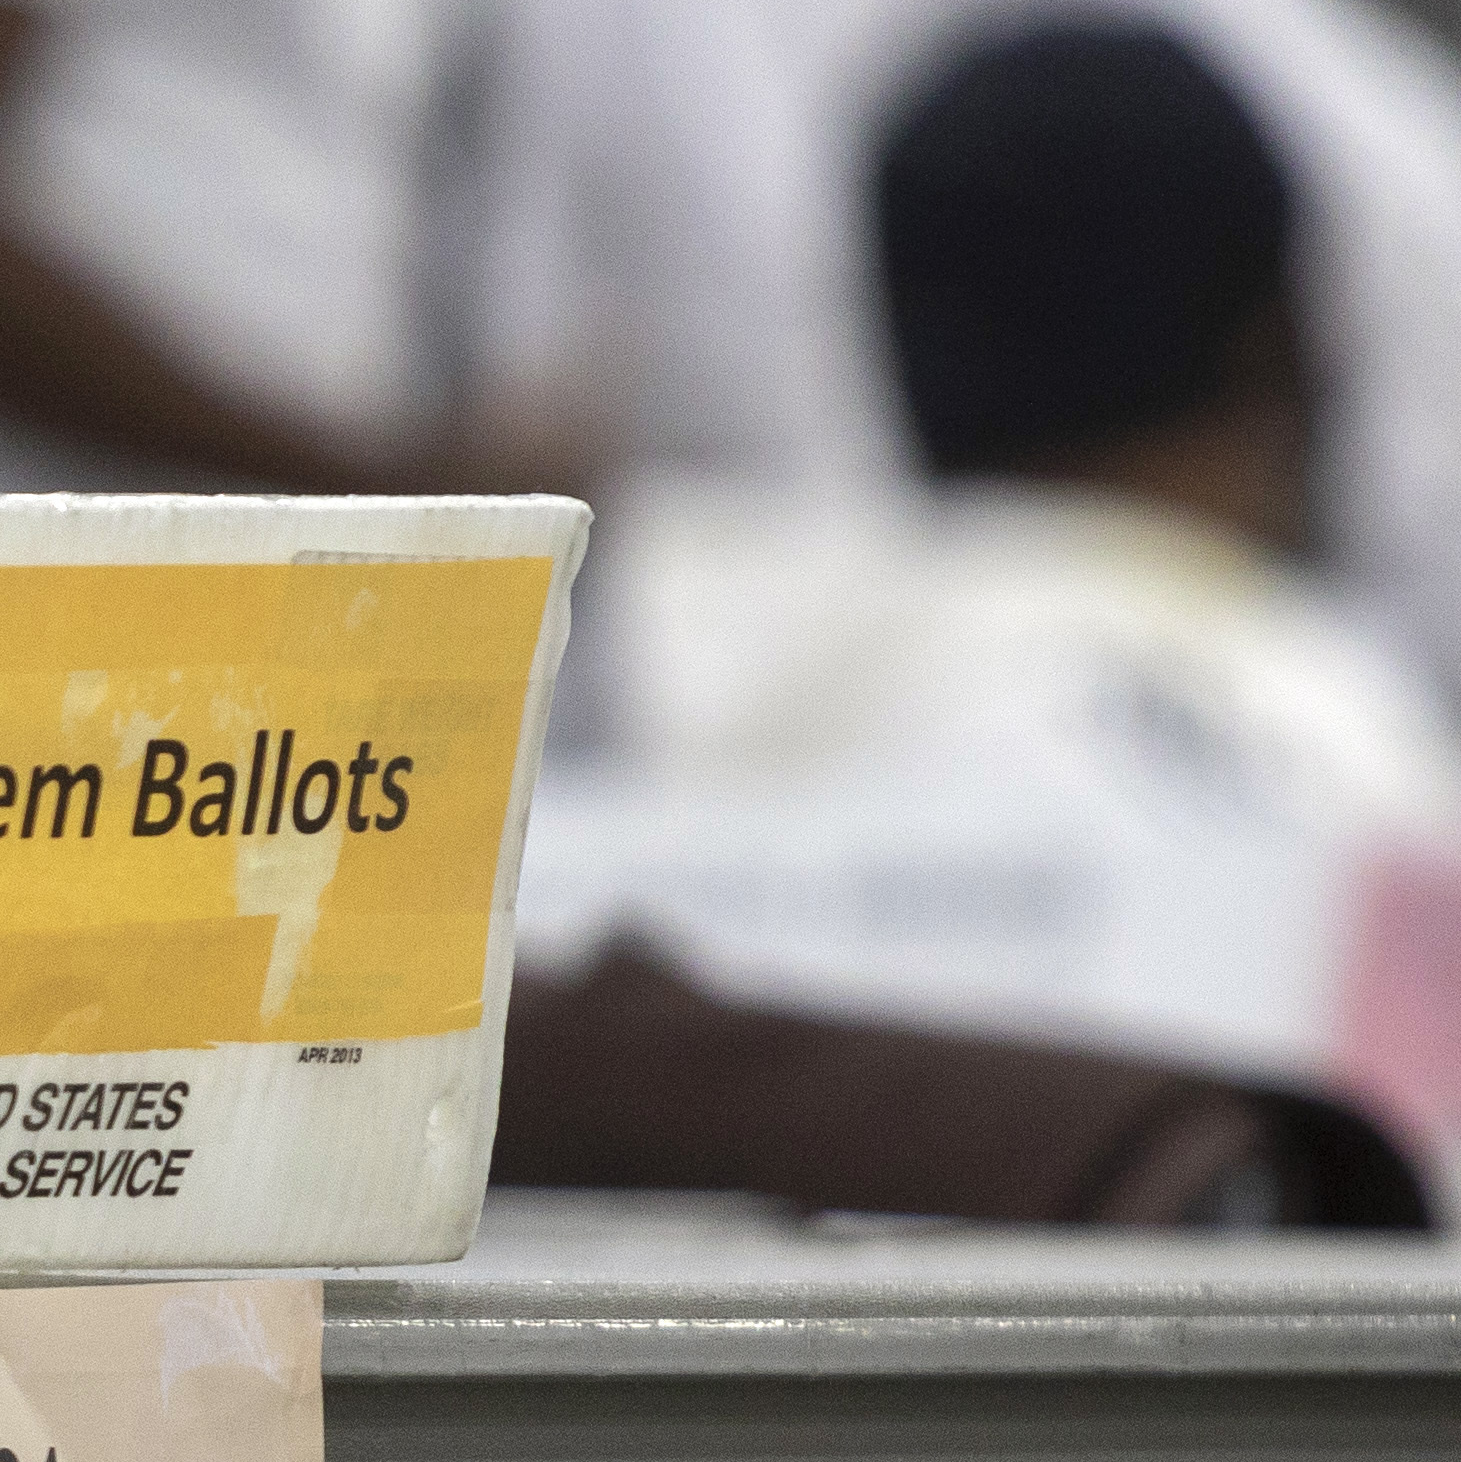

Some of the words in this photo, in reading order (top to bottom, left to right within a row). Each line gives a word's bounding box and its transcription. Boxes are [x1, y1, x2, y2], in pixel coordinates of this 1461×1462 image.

[131, 728, 413, 838] Ballots
[297, 1046, 328, 1065] APR
[328, 1046, 363, 1064] 2013
[21, 1080, 190, 1131] STATES
